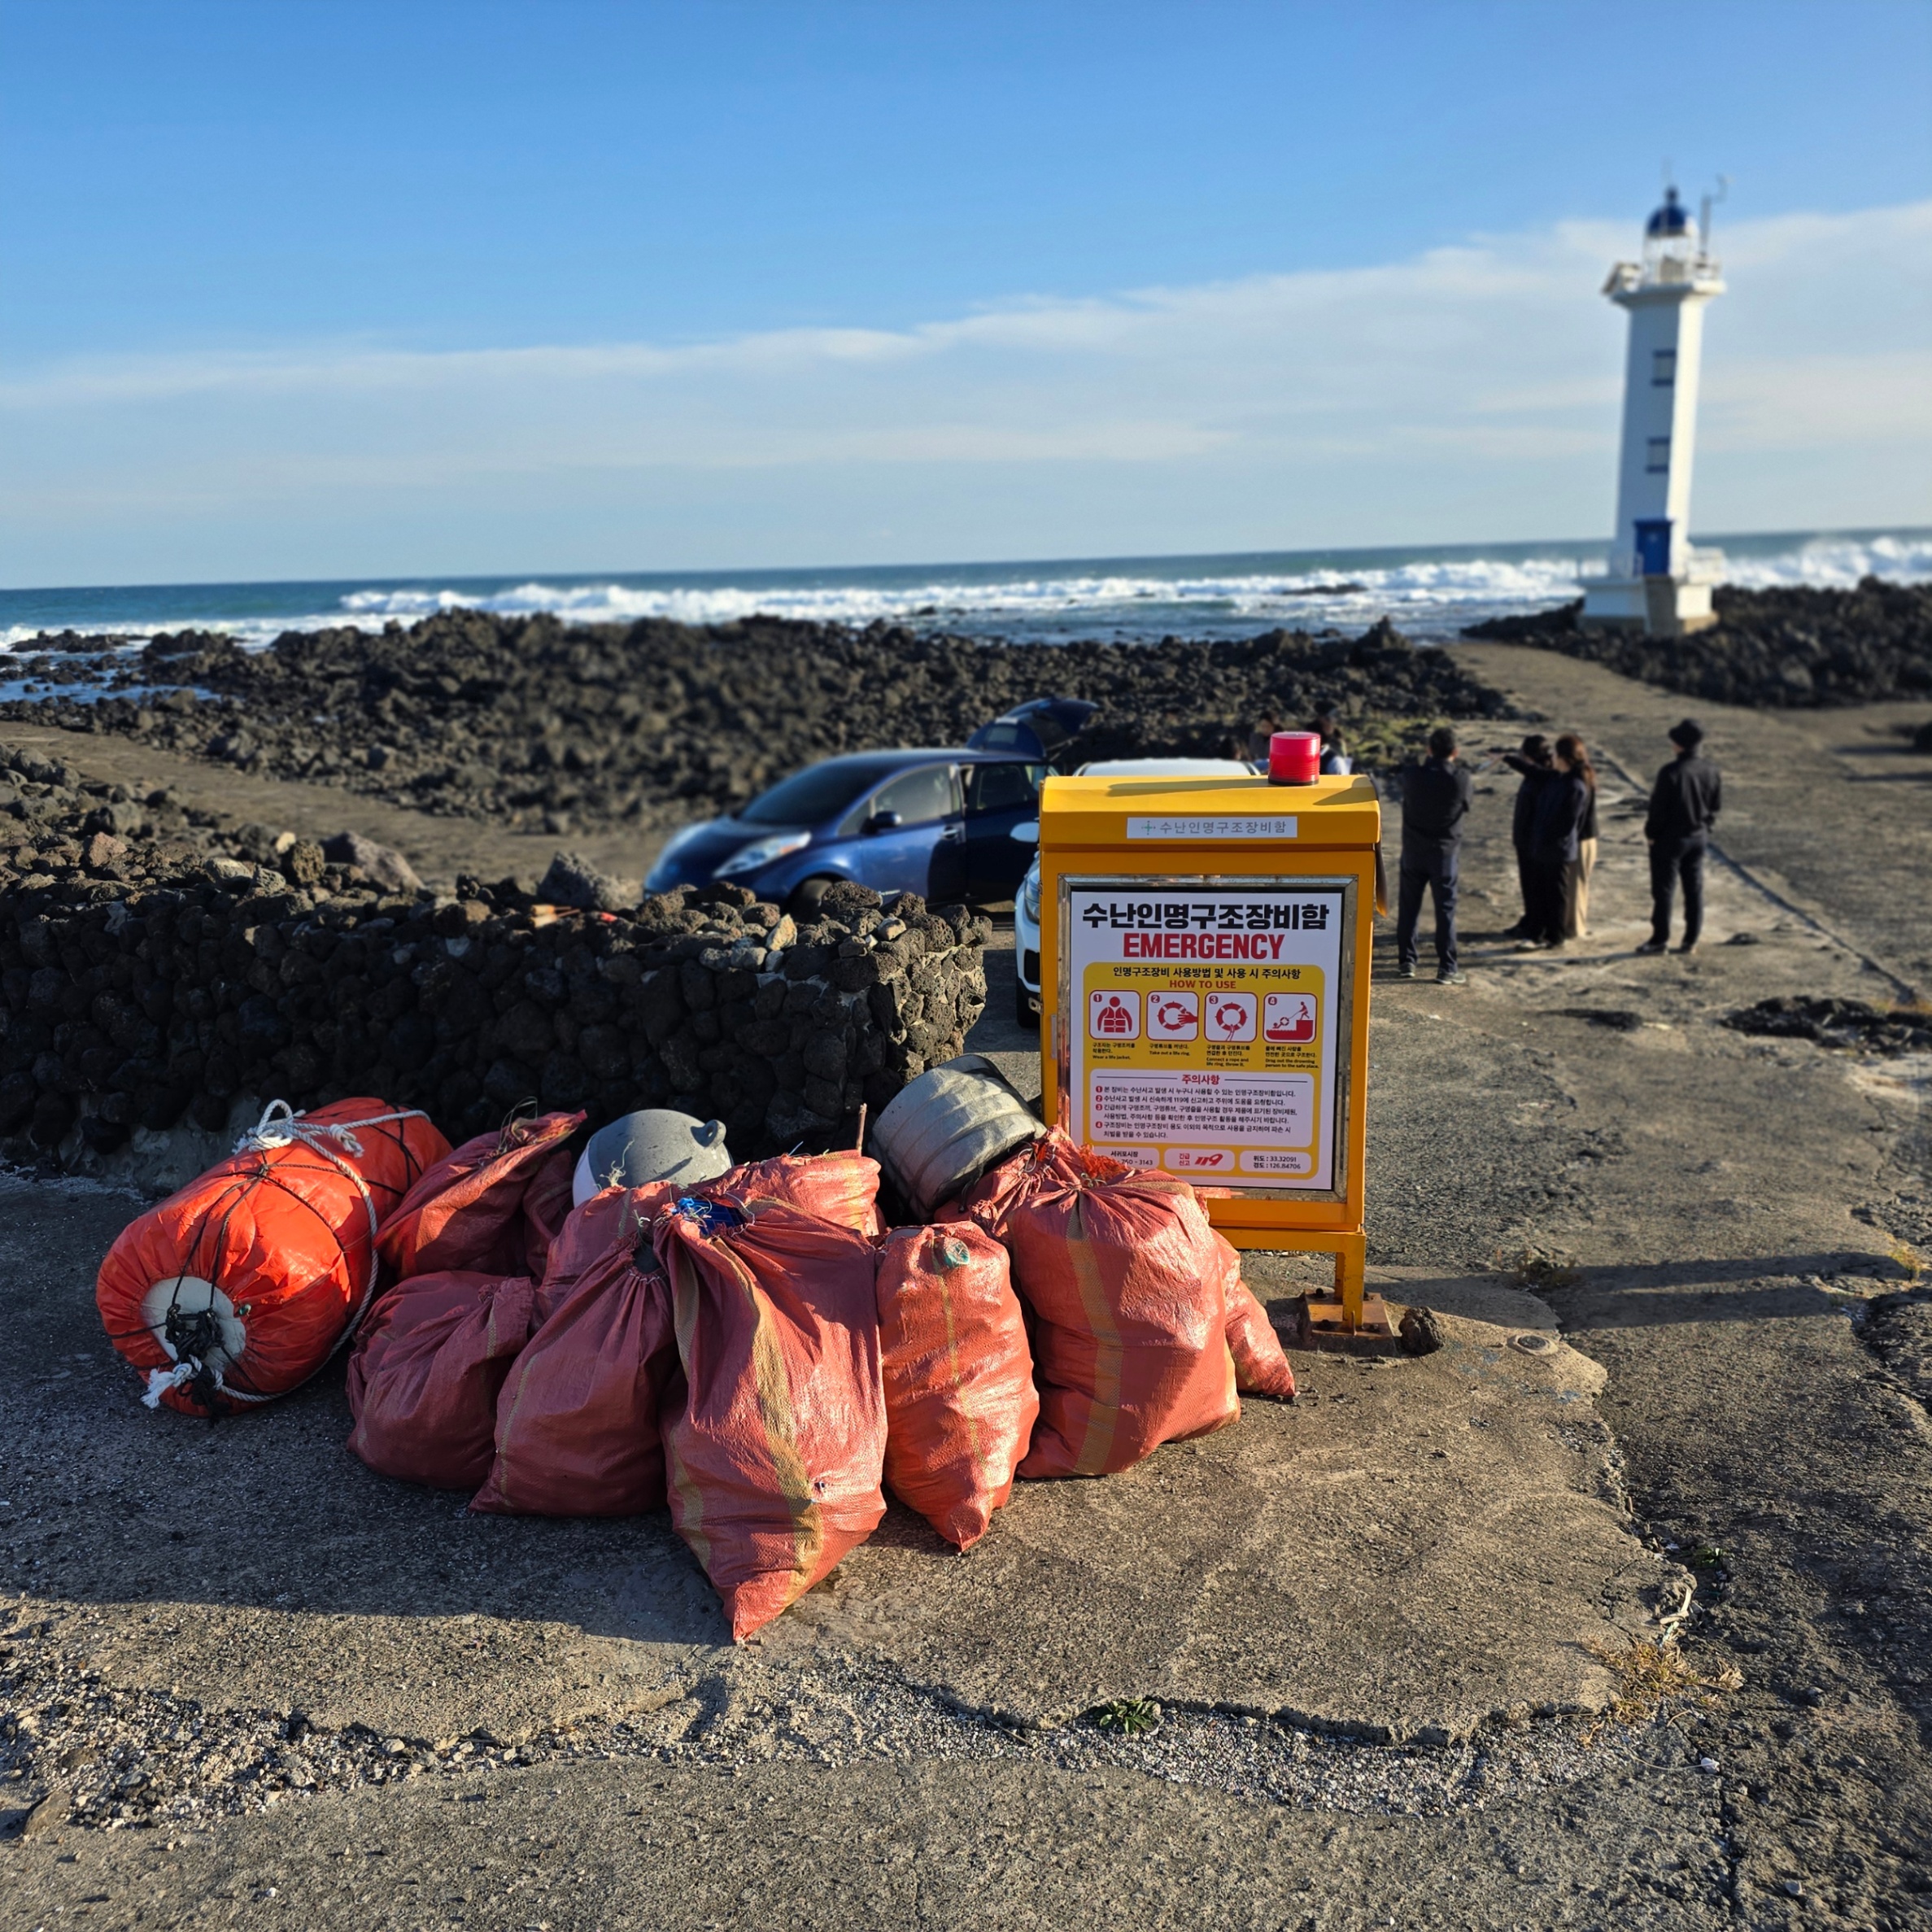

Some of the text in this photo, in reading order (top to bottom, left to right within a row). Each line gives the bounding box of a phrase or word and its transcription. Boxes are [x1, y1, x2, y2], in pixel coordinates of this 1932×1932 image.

[1160, 821, 1286, 834] 수난인명구조장비함
[1083, 903, 1329, 930] 수난인명구조장비함
[1123, 933, 1285, 959] EMERGENCY
[1114, 967, 1301, 979] 인명구조장비 사용방법 및 사용 시 주의사항
[1170, 980, 1196, 988] HOW
[1198, 980, 1212, 988] TO
[1182, 1075, 1220, 1085] 주의사항
[1194, 1154, 1223, 1166] 119
